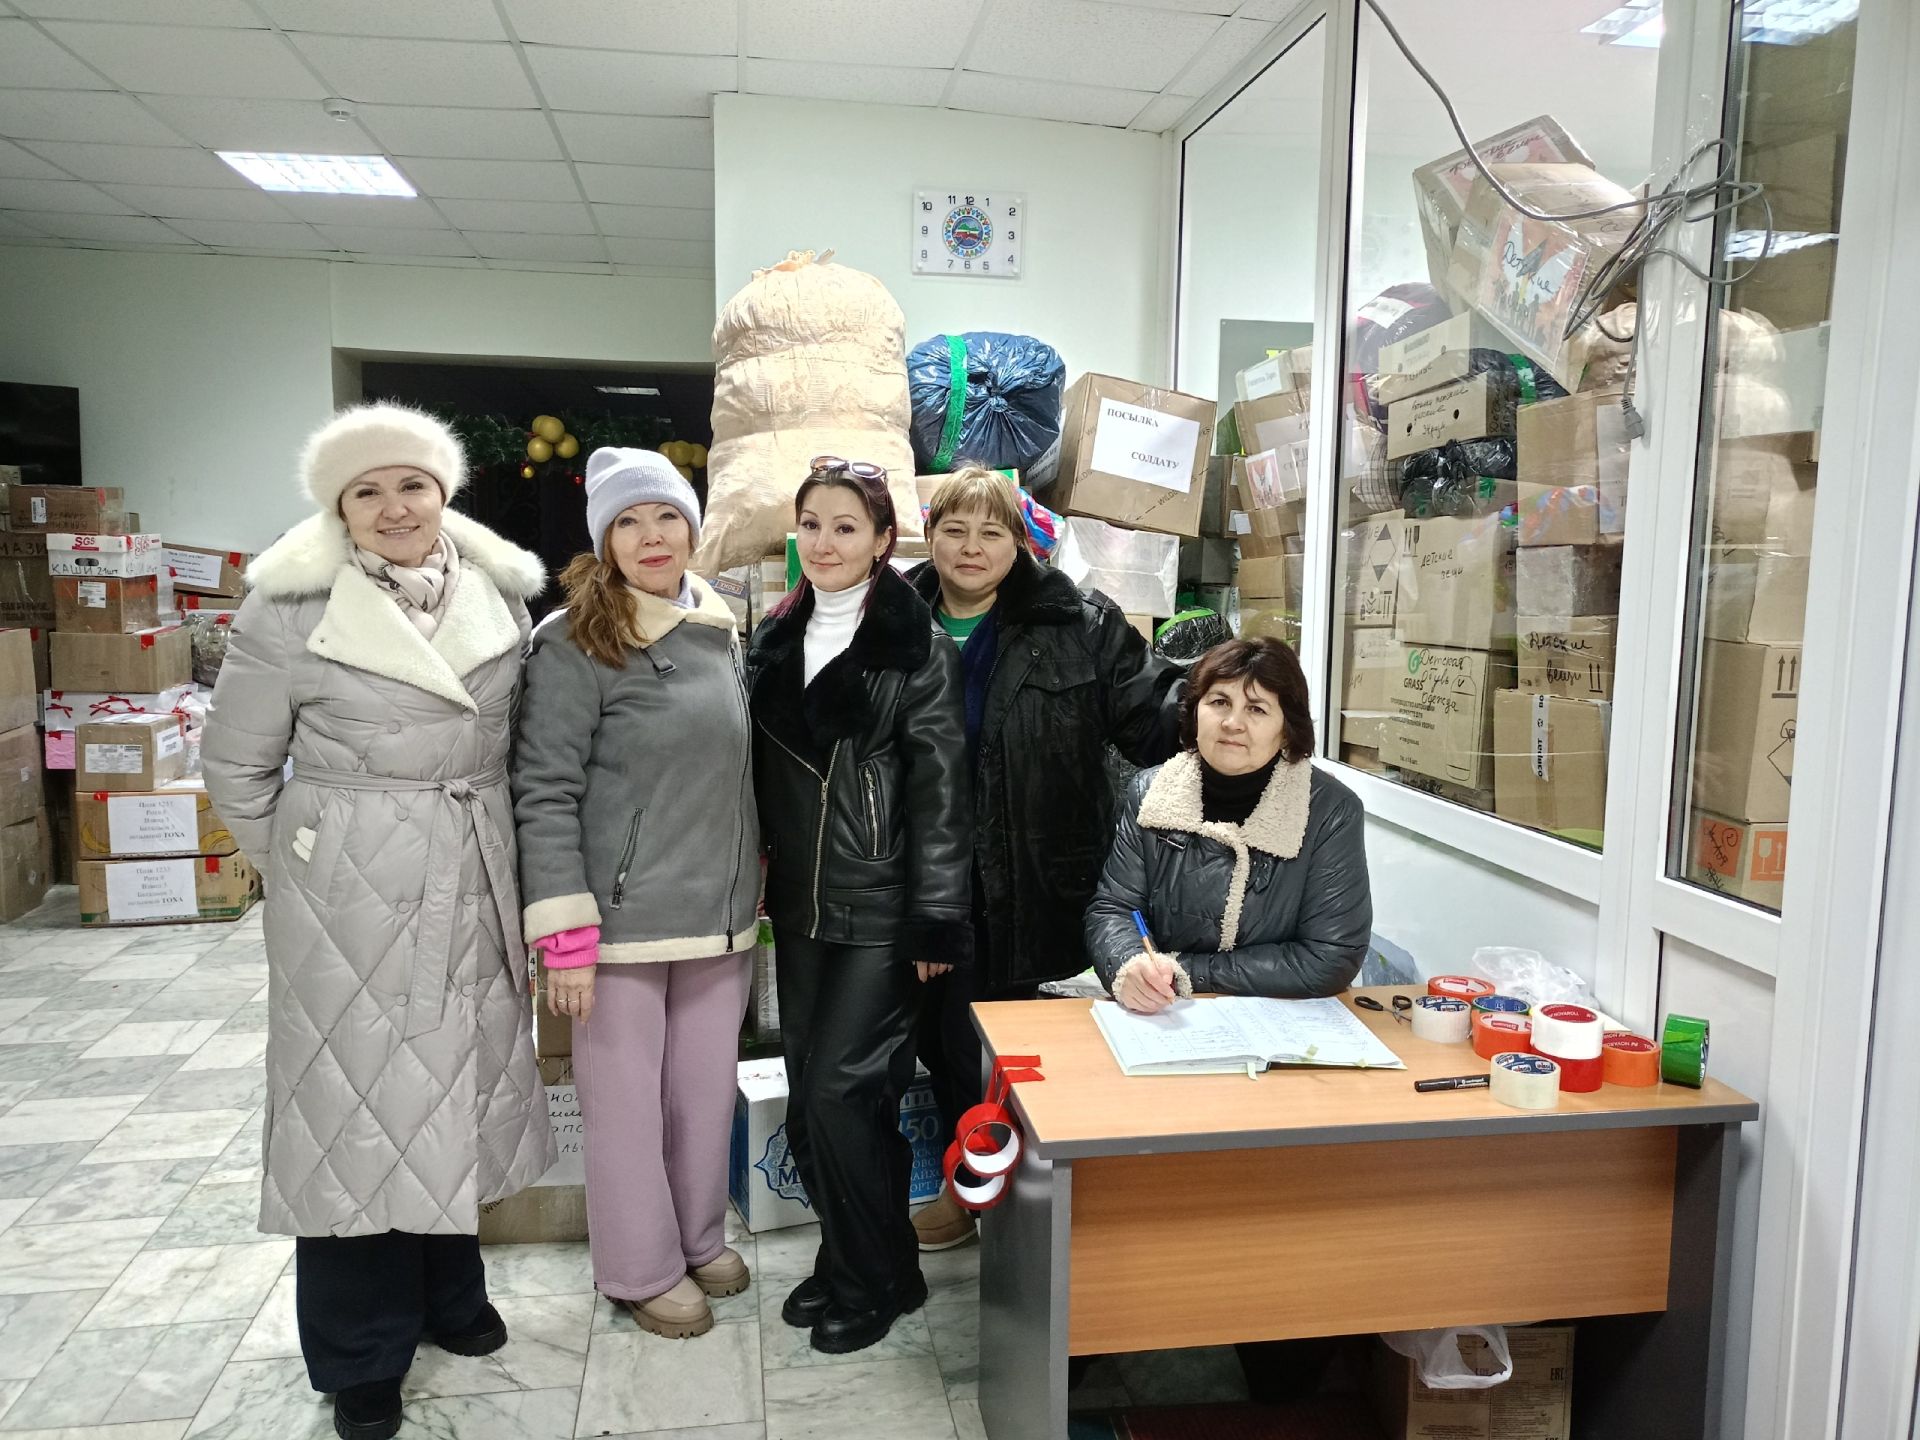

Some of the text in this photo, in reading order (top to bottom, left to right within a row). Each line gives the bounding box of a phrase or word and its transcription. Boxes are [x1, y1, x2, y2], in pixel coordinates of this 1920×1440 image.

[948, 195, 956, 204] 11
[965, 196, 975, 205] 12
[985, 198, 990, 207] 1
[922, 201, 932, 211] 10
[1008, 207, 1016, 216] 2
[921, 226, 928, 235] 9
[1008, 231, 1015, 240] 3
[921, 250, 928, 259] 8
[947, 259, 954, 268] 7
[1007, 255, 1014, 264] 4
[964, 260, 971, 269] 6
[983, 261, 990, 270] 5
[1107, 408, 1159, 428] ПОСЫЛКА
[1131, 451, 1180, 469] СОЛДАТУ
[74, 536, 96, 547] SGS
[51, 563, 93, 575] КАШИ
[1403, 678, 1424, 691] GRASS
